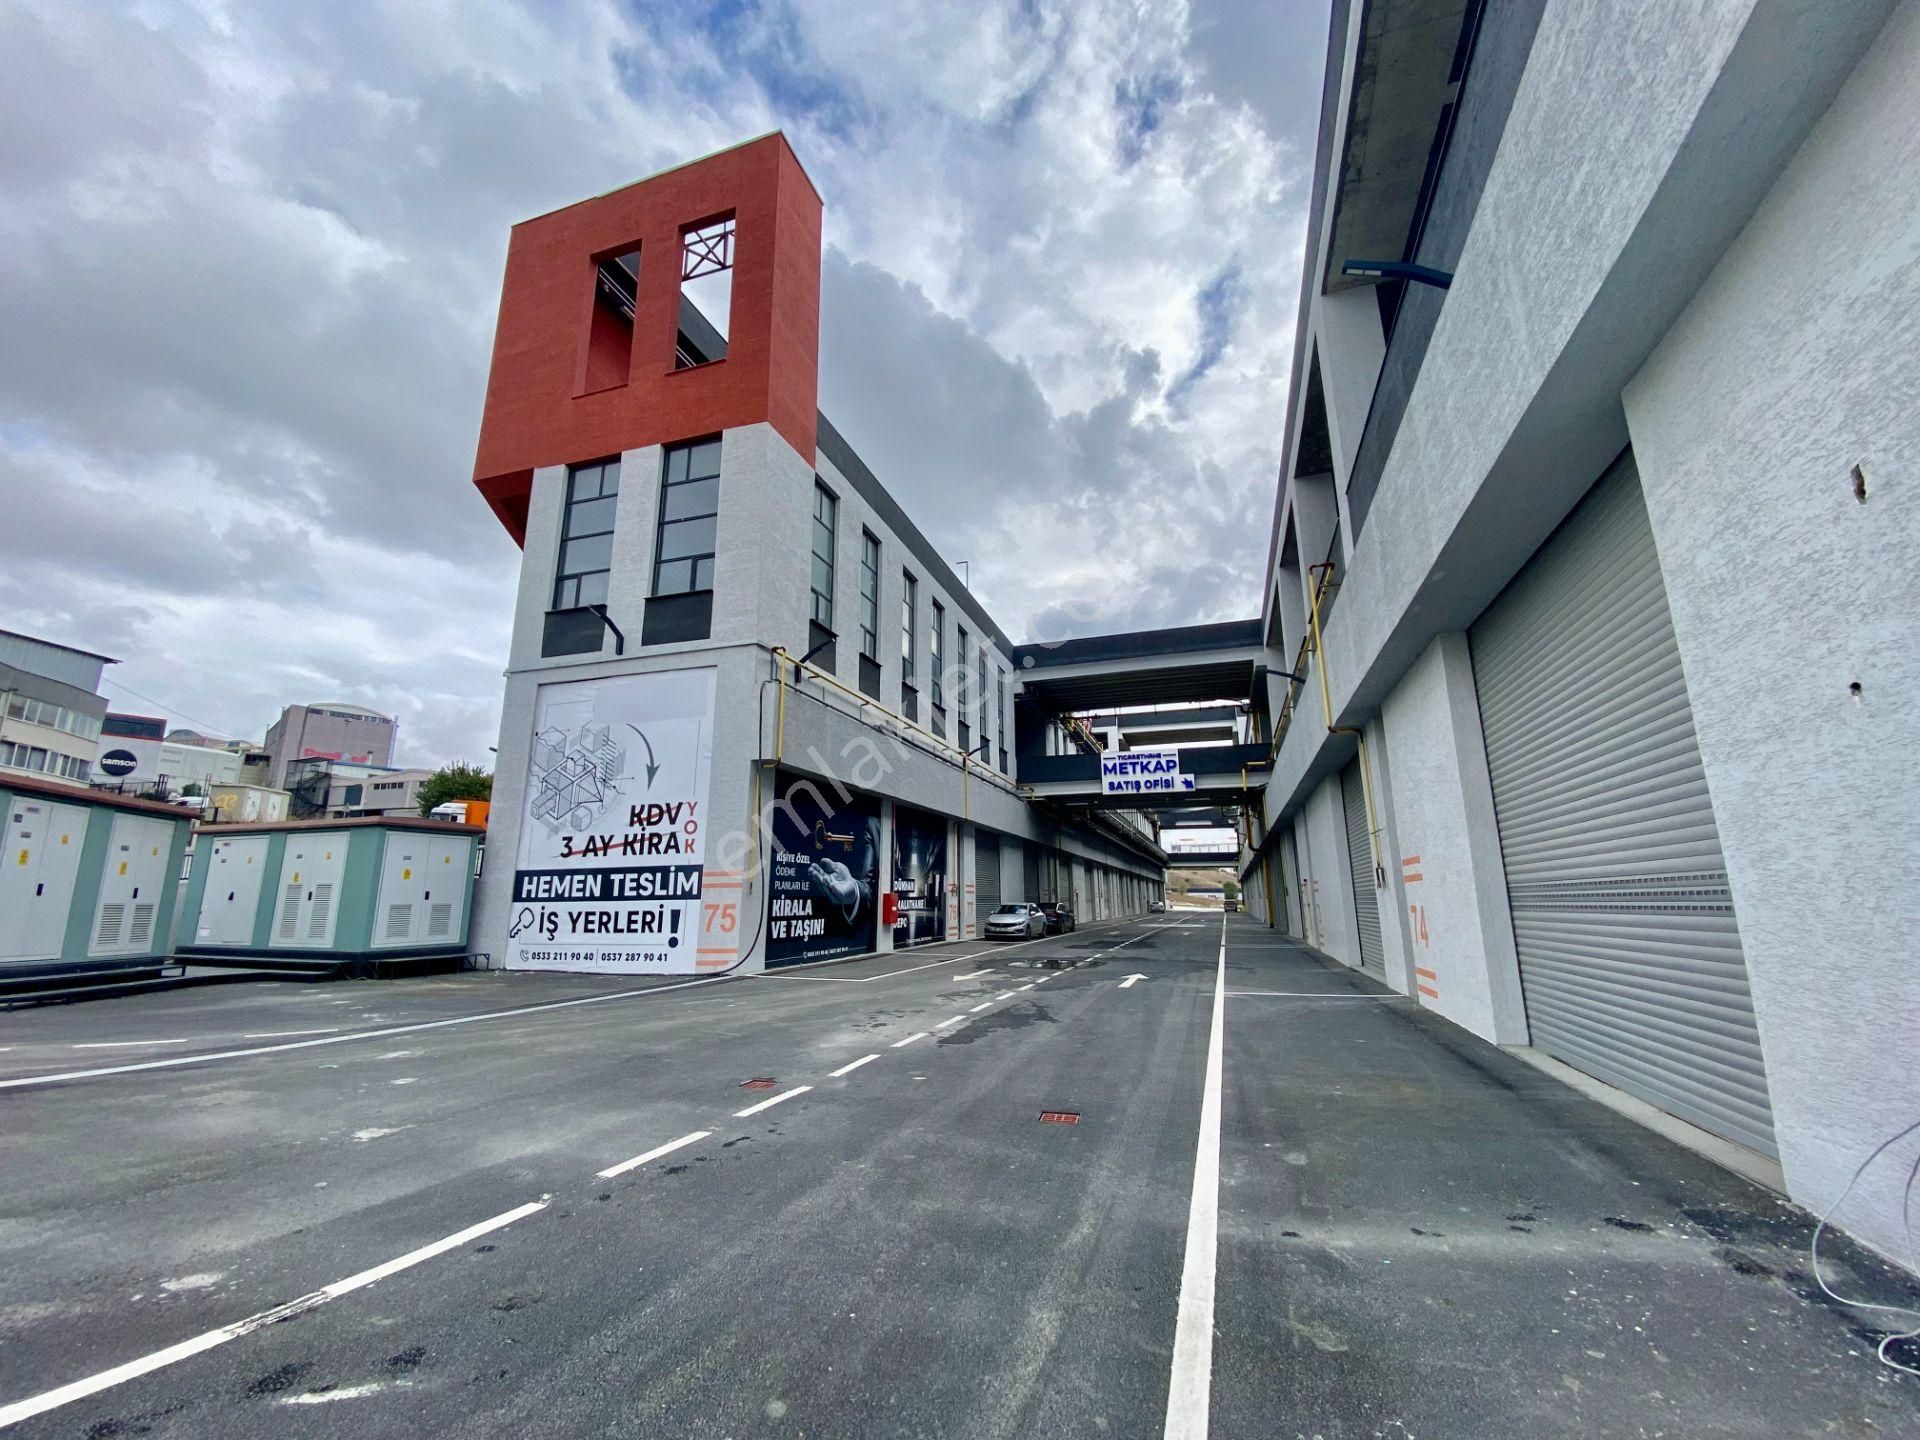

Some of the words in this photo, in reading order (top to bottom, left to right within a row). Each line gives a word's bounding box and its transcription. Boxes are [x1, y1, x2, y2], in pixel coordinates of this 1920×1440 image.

[1103, 760, 1177, 775] METKAP
[1108, 779, 1141, 793] SATIŞ
[629, 802, 683, 827] KDV
[560, 835, 574, 859] 3
[582, 834, 614, 857] AY
[622, 827, 681, 855] KİRA
[796, 852, 810, 864] ÖZEL
[522, 874, 602, 898] HEMEN
[610, 866, 699, 897] TESLİM
[772, 895, 812, 917] KİRALA
[539, 907, 559, 941] İŞ
[704, 904, 736, 933] 75
[771, 921, 786, 939] VE
[790, 919, 824, 942] TAŞIN!
[1411, 905, 1428, 947] 74
[531, 952, 552, 961] 0533
[553, 952, 568, 961] 211
[570, 952, 582, 961] 90
[583, 952, 594, 961] 40
[601, 952, 621, 962] 0537
[624, 952, 640, 961] 287
[643, 952, 655, 961] 90
[656, 952, 668, 961] 41
